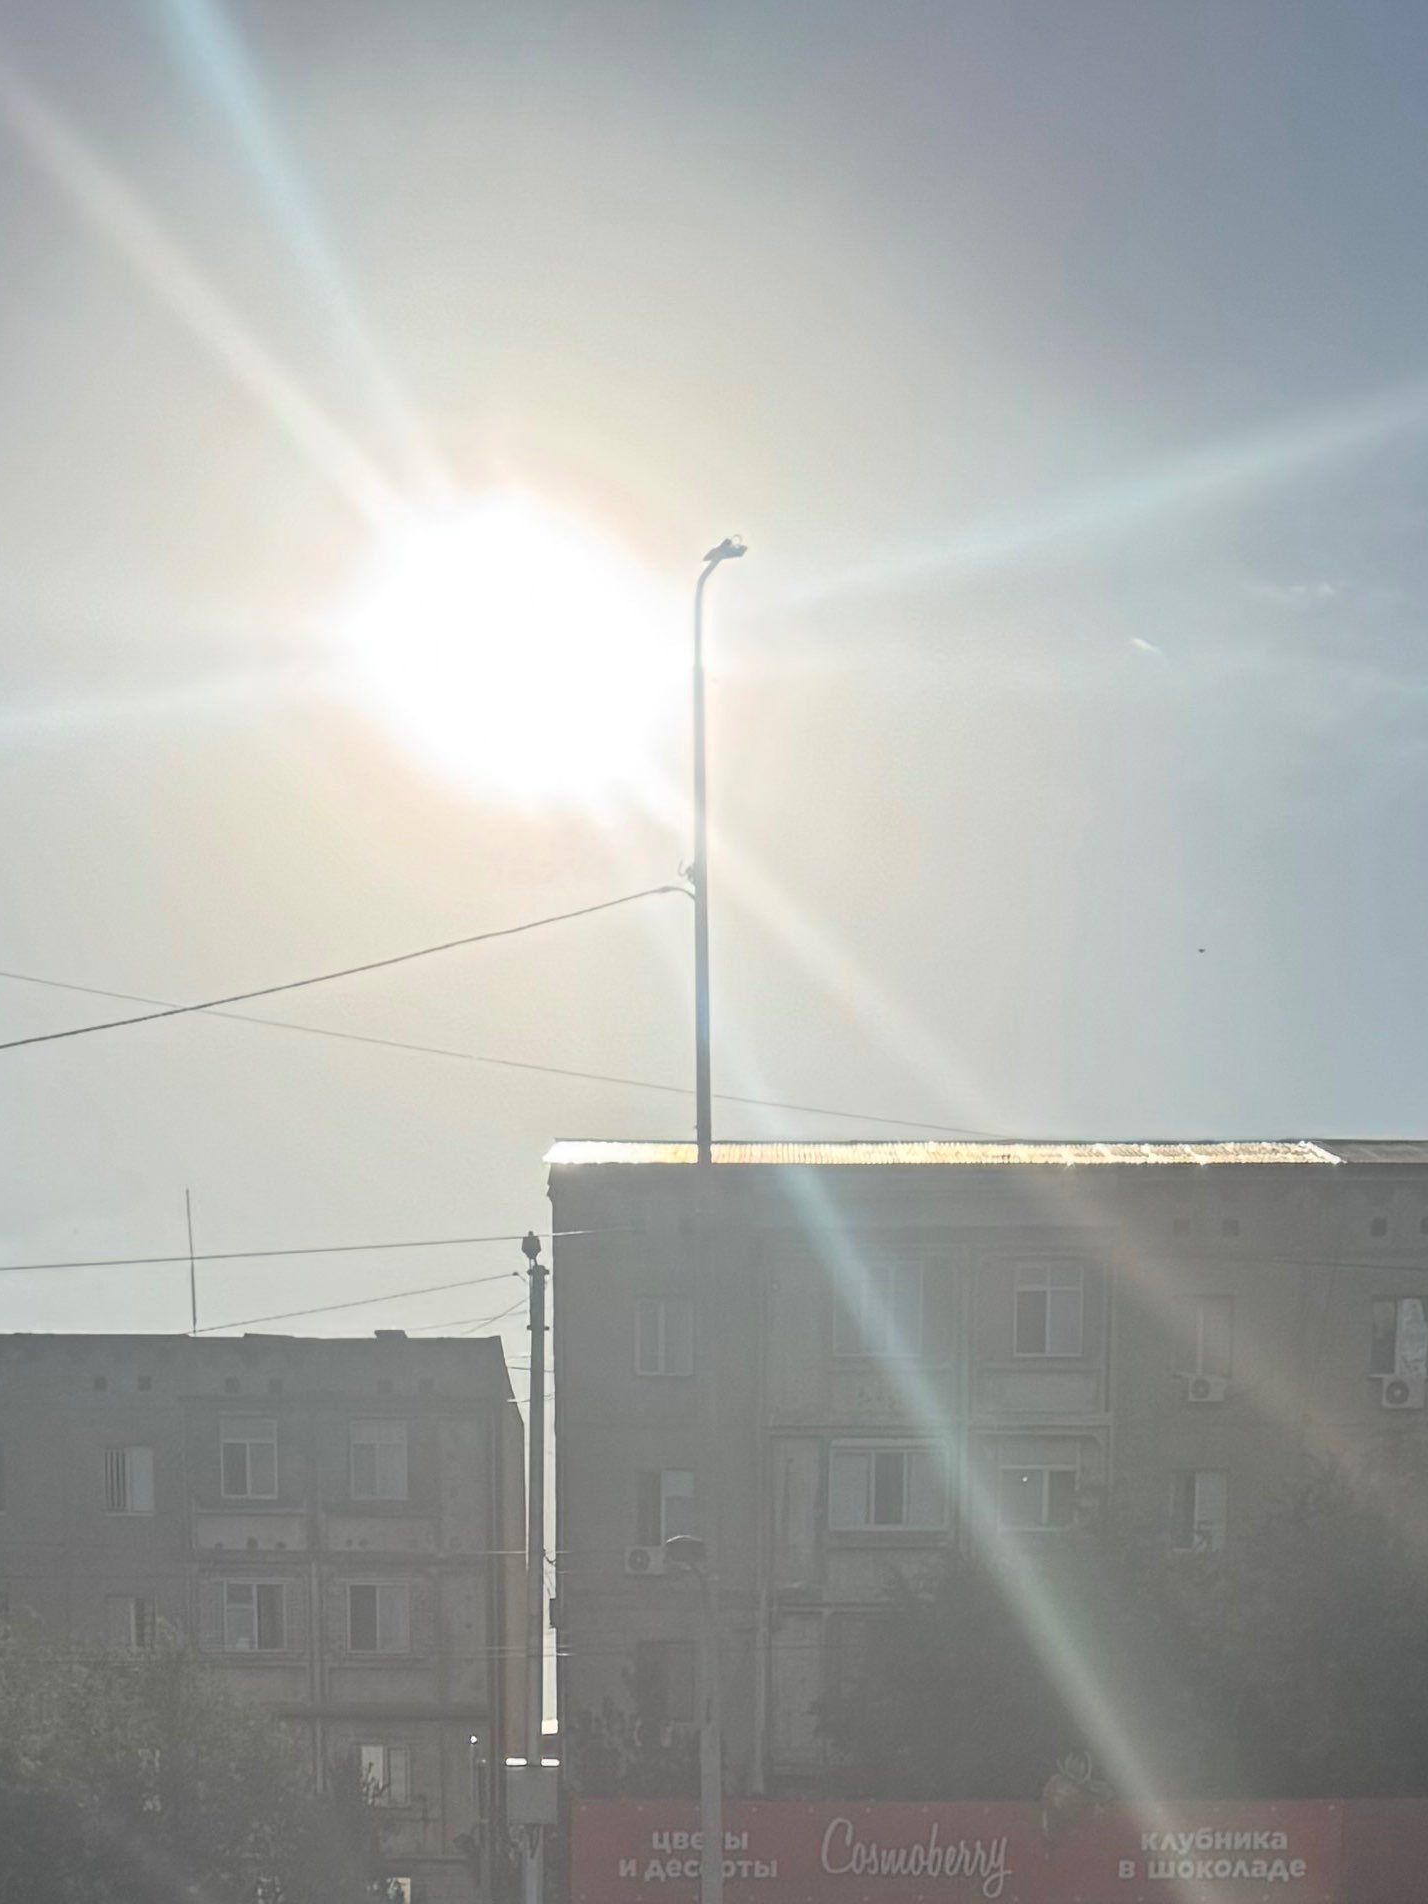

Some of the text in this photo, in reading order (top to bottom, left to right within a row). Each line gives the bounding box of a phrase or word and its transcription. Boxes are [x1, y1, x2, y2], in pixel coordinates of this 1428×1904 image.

[652, 1830, 749, 1854] цвеы
[1141, 1827, 1289, 1855] клубника
[619, 1858, 637, 1878] и
[822, 1817, 1012, 1899] Cosmoberry
[1118, 1858, 1307, 1882] в шоколаде
